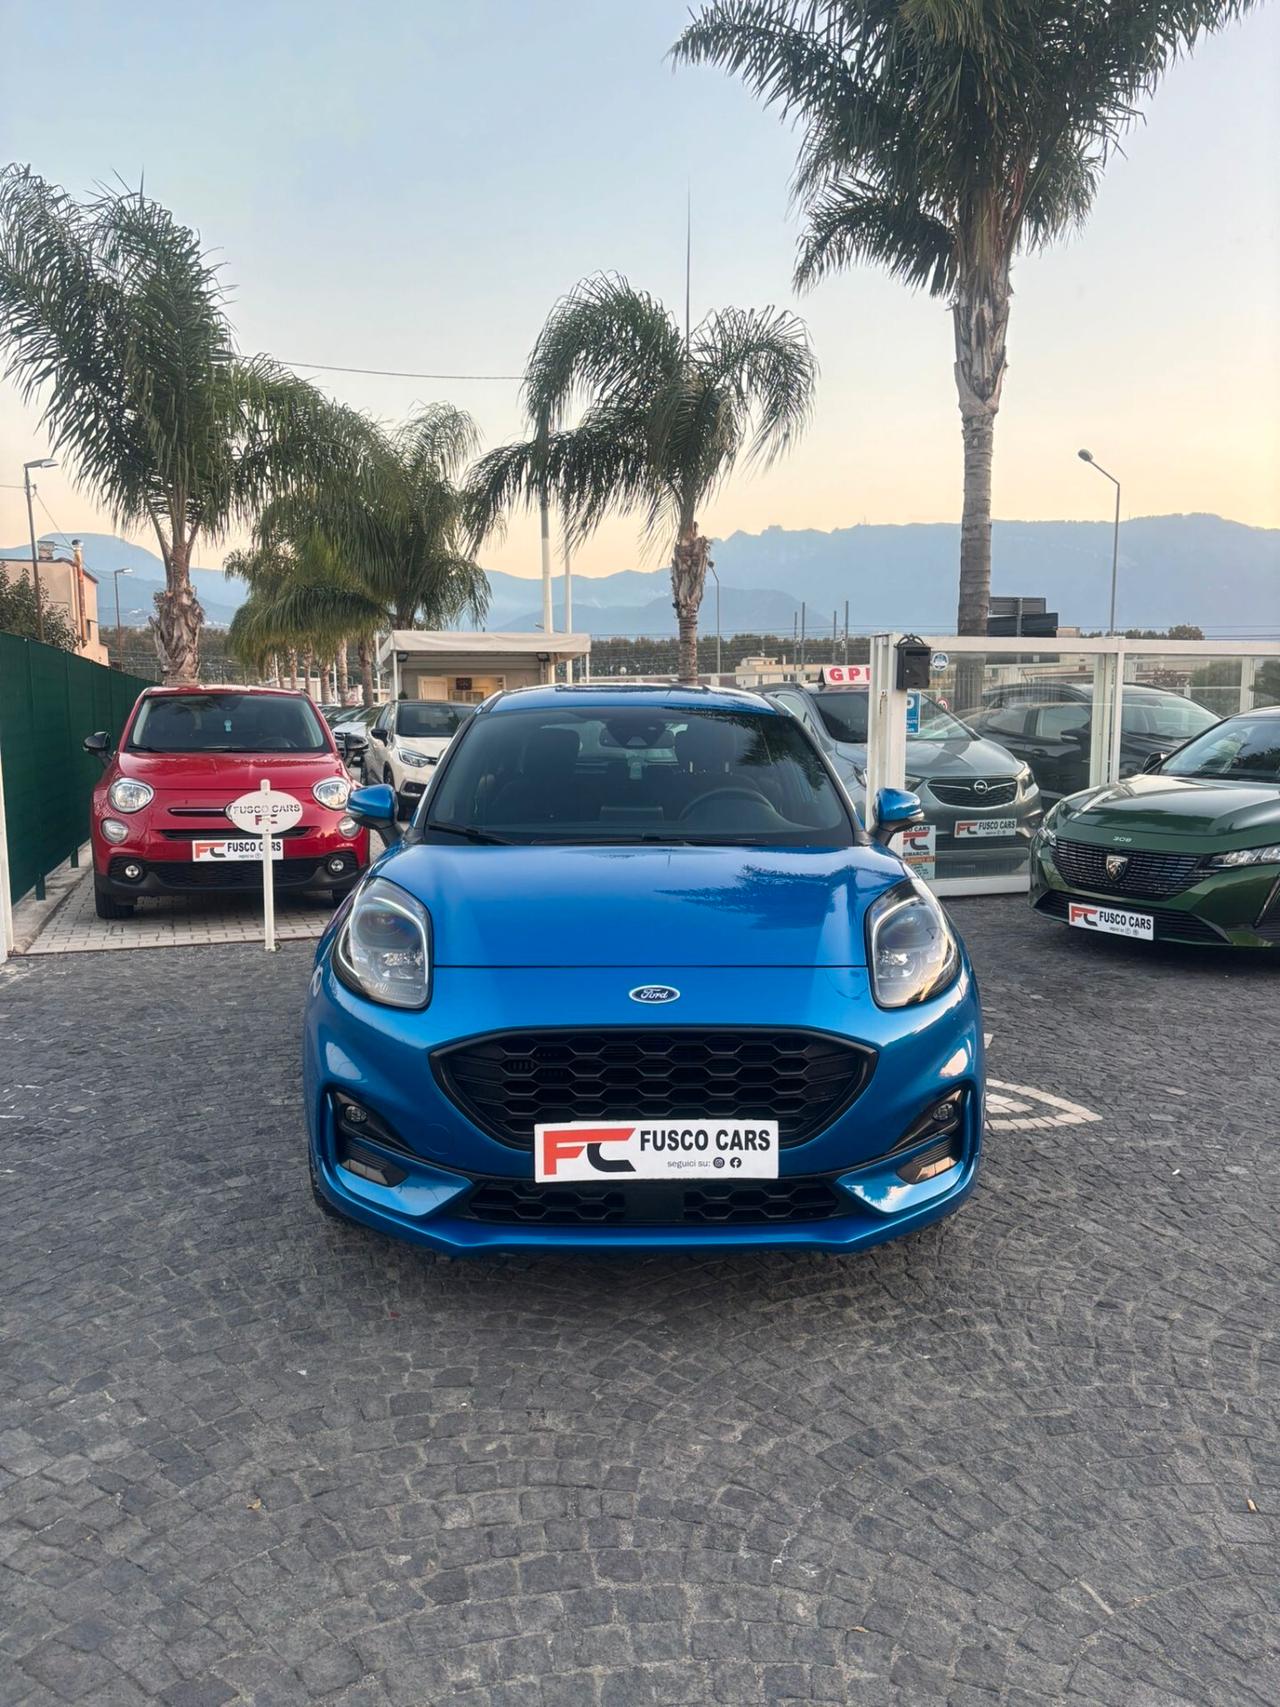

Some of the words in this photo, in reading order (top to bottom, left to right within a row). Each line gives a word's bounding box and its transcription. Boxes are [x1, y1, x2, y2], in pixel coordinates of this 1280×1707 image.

[233, 805, 268, 814] FUSCO
[272, 804, 300, 813] CARS
[979, 821, 999, 831] FUSCO
[999, 820, 1016, 829] CARS
[227, 842, 256, 852] FUSCO
[259, 842, 281, 852] CRS
[1099, 911, 1126, 926] FUSCO
[1129, 916, 1152, 930] CARS
[640, 988, 669, 999] Ford
[640, 1130, 709, 1152] FUSCO
[715, 1129, 771, 1152] CARS
[543, 1127, 636, 1176] FC
[667, 1159, 697, 1169] seguici
